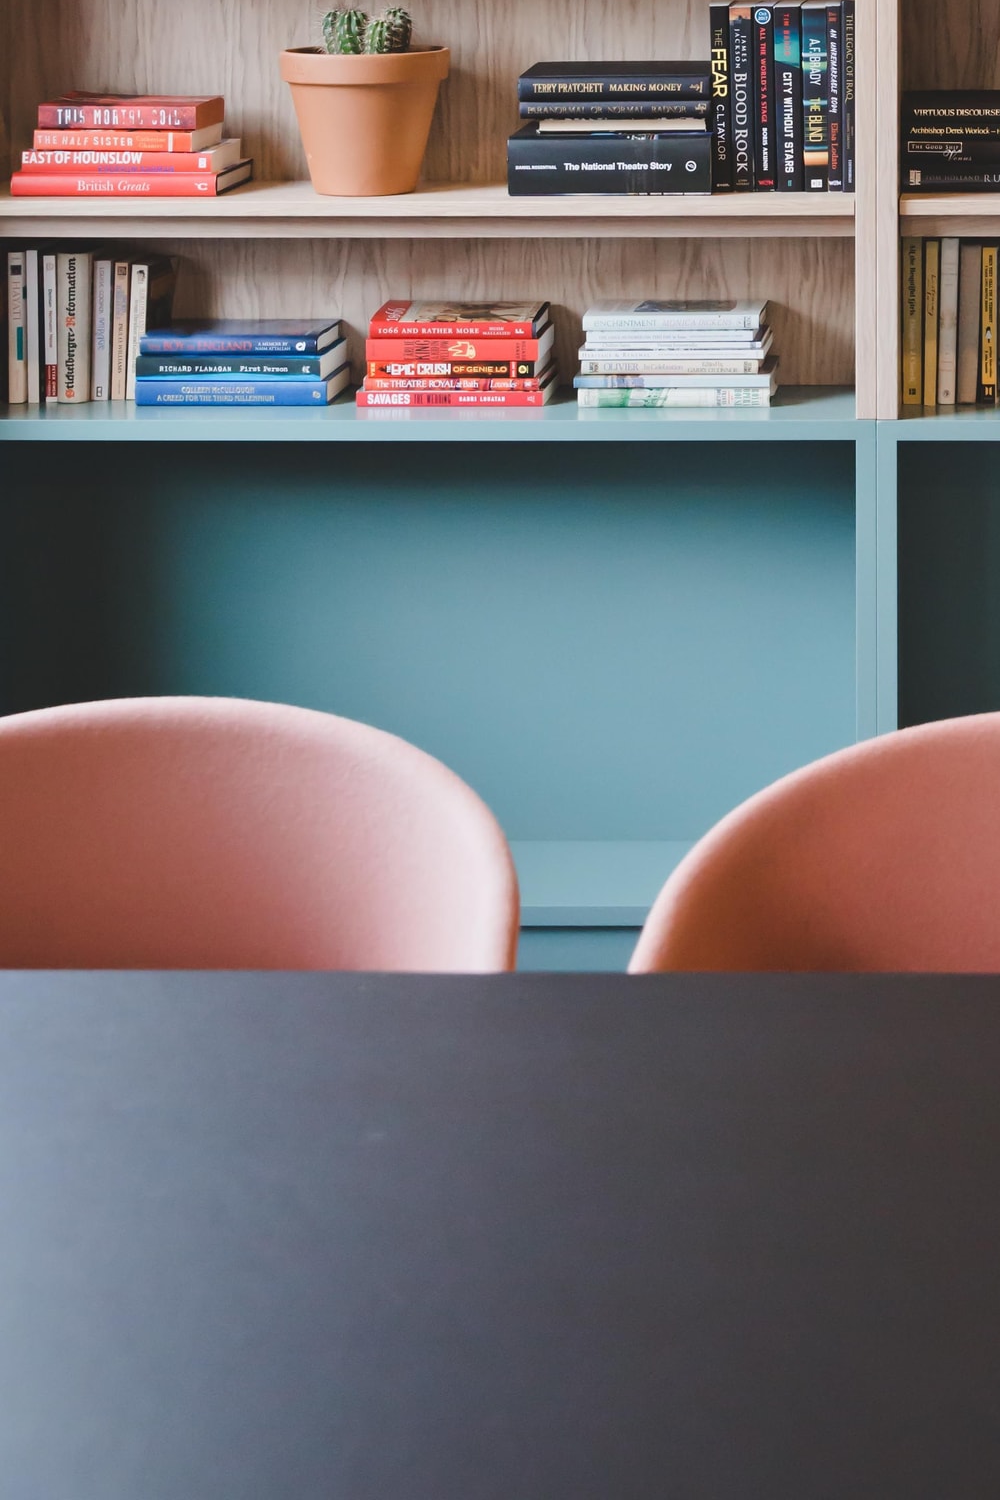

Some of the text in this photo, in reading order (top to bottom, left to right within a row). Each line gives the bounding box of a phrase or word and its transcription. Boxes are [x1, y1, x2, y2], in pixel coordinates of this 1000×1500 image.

[712, 28, 728, 97] THE FEAR
[533, 83, 604, 93] TERRY PRATCHETT
[609, 83, 682, 92] MAKING MONEY
[734, 72, 748, 172] BLOOD ROCK
[783, 72, 794, 173] CITY WITHOUT STARS
[22, 152, 142, 164] EAST OF HOUNSLOW
[564, 162, 672, 171] The National Theatre Story
[77, 180, 150, 191] British Greats
[391, 363, 414, 375] EPIC
[417, 363, 451, 375] CRUSH
